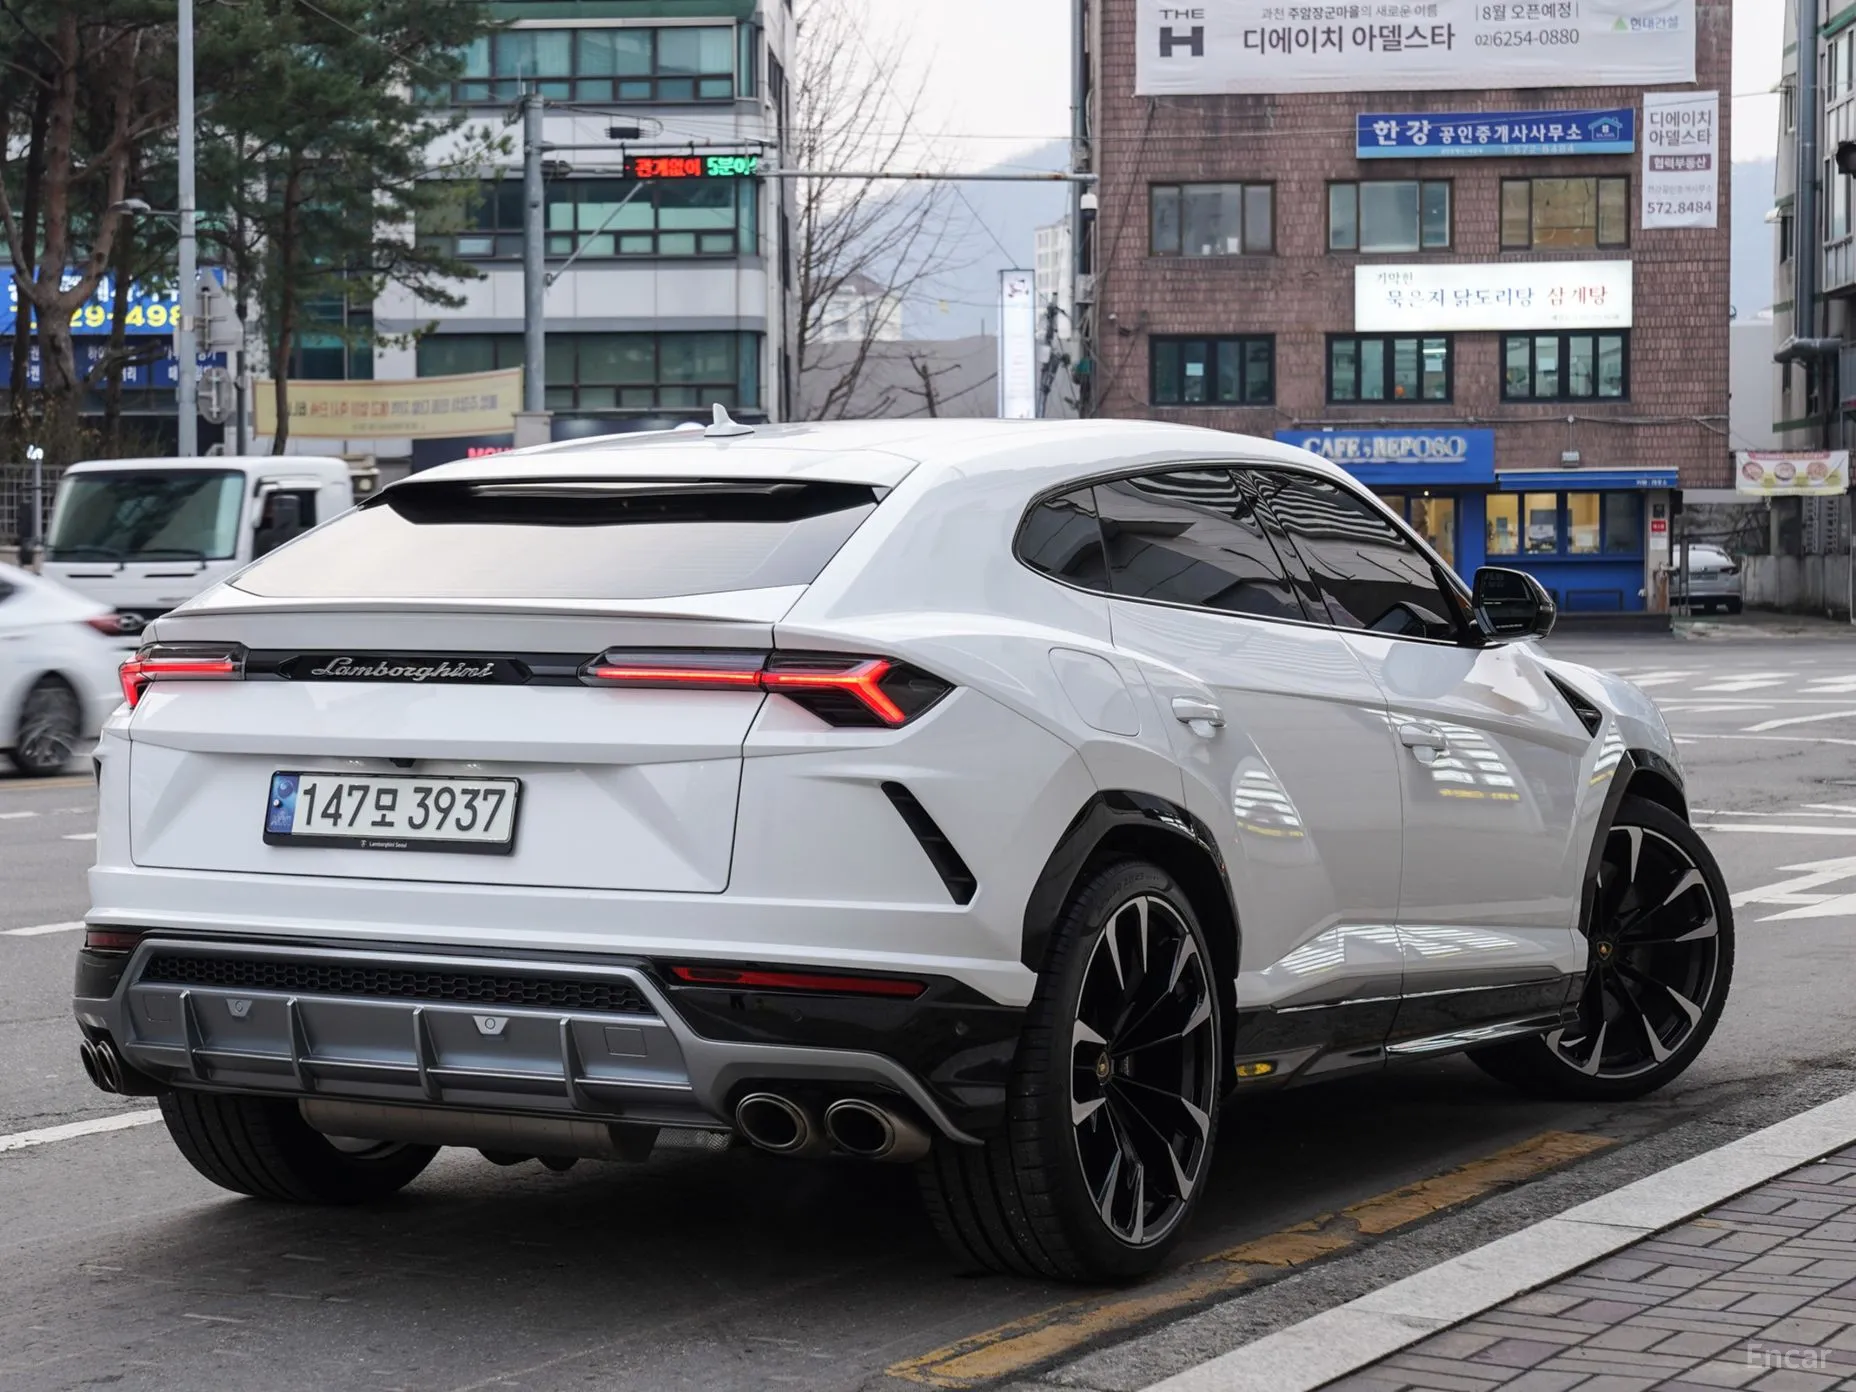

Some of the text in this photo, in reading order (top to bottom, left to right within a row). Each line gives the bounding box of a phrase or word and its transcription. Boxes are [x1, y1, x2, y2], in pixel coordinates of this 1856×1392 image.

[1159, 9, 1205, 19] THE
[1261, 4, 1438, 20] 과천 주암장군마을의 새로운 이름
[1482, 3, 1572, 21] 8월 오픈예정
[1630, 16, 1679, 31] 현대건설
[1159, 26, 1204, 57] H
[1243, 23, 1455, 54] 디에이치 아델스타
[1475, 28, 1580, 47] 02)6254-0880
[1650, 110, 1712, 128] 디에이치
[1438, 123, 1583, 145] 공인중개사사무소
[1649, 128, 1712, 147] 아델스타
[1654, 155, 1707, 170] 협력부동산
[1647, 201, 1712, 215] 572.8484
[1386, 288, 1445, 309] 묵은지
[311, 657, 495, 681] Lamborghini
[302, 782, 399, 828] 147모
[407, 786, 507, 833] 3937
